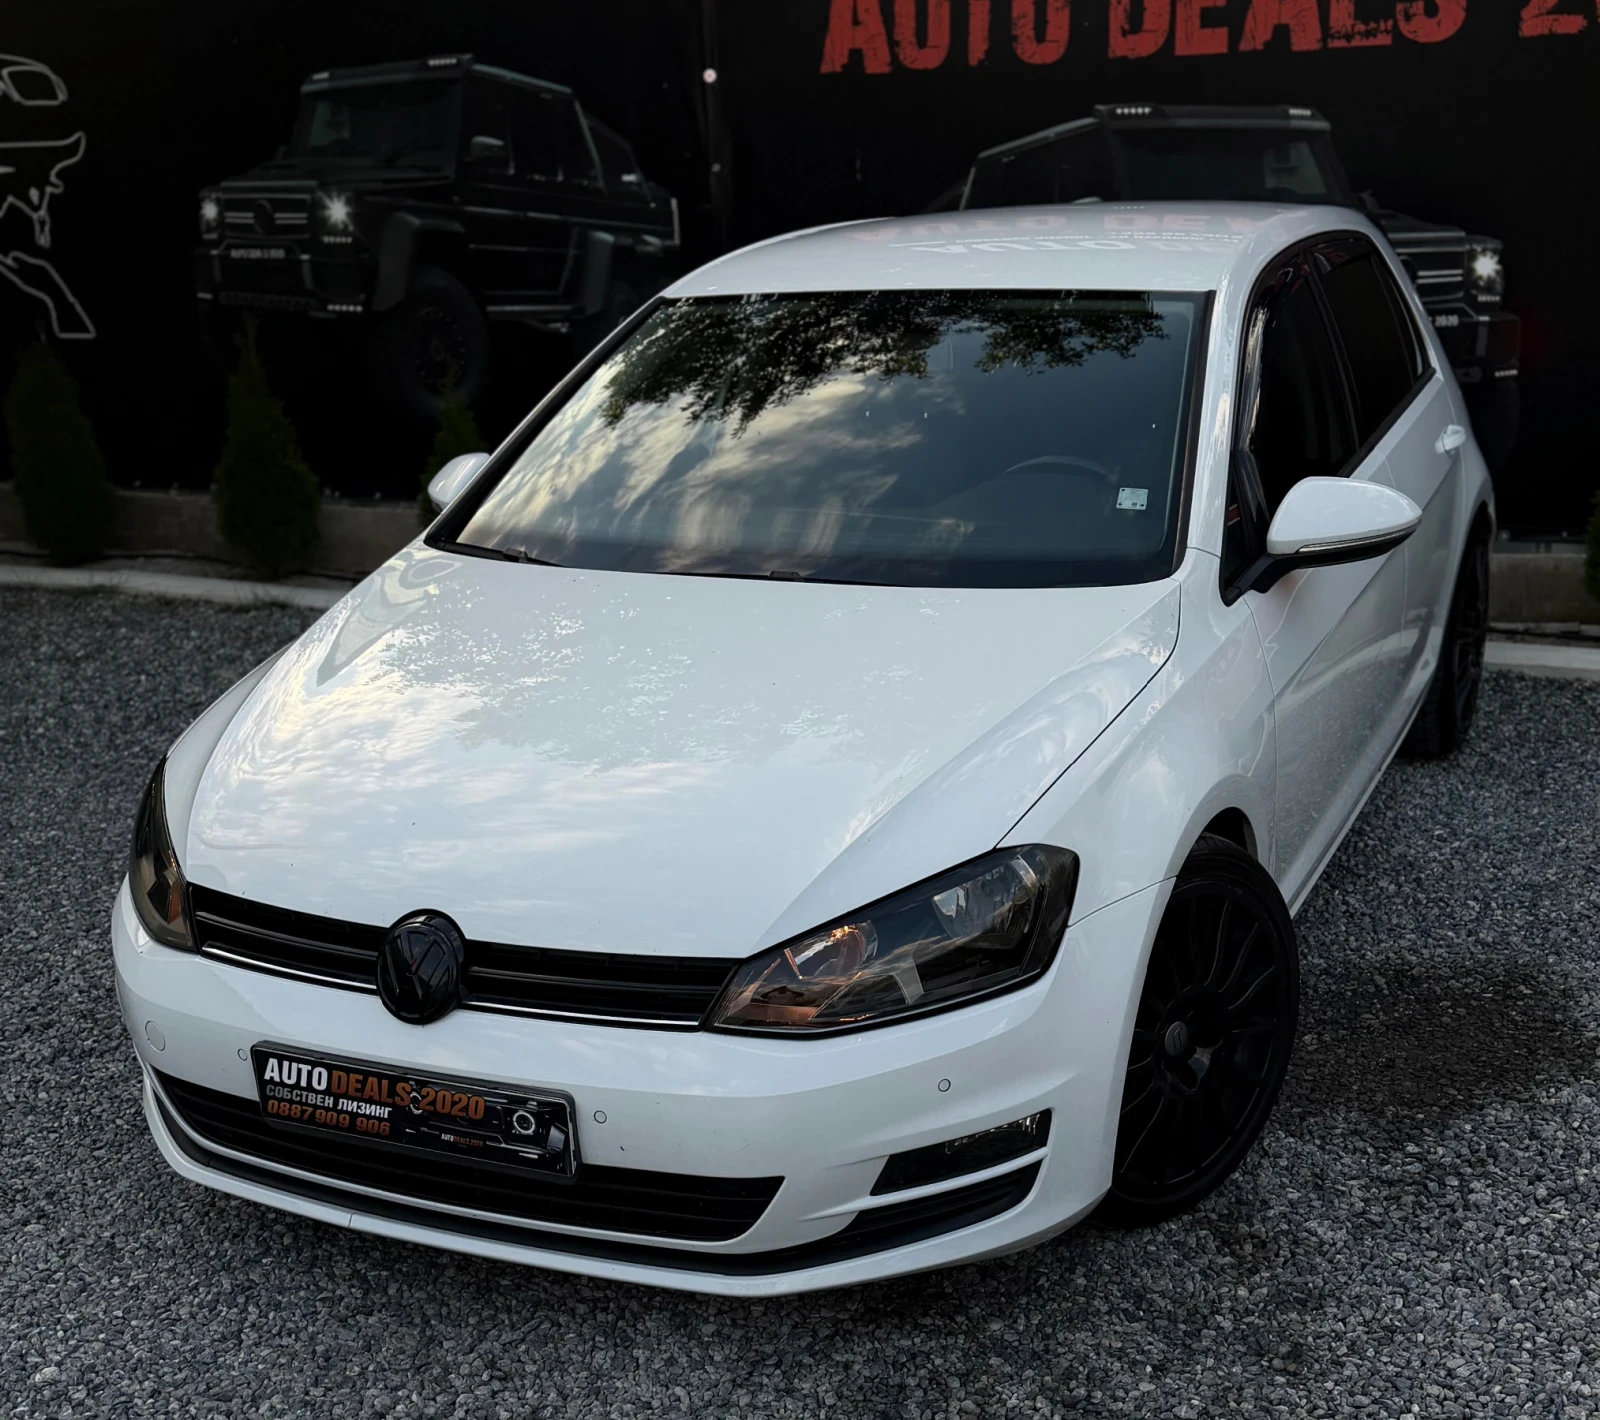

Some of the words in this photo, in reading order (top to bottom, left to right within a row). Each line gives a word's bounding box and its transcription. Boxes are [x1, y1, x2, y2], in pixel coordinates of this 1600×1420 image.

[820, 0, 1070, 74] AUTO
[263, 1057, 328, 1091] AUTO
[330, 1069, 413, 1107] DEALS
[418, 1086, 485, 1120] 2020
[265, 1084, 334, 1108] СОБСТВЕН
[337, 1098, 393, 1119] ЛИЗИНГ
[267, 1099, 314, 1121] 0887
[315, 1109, 350, 1128] 909
[356, 1117, 391, 1137] 906
